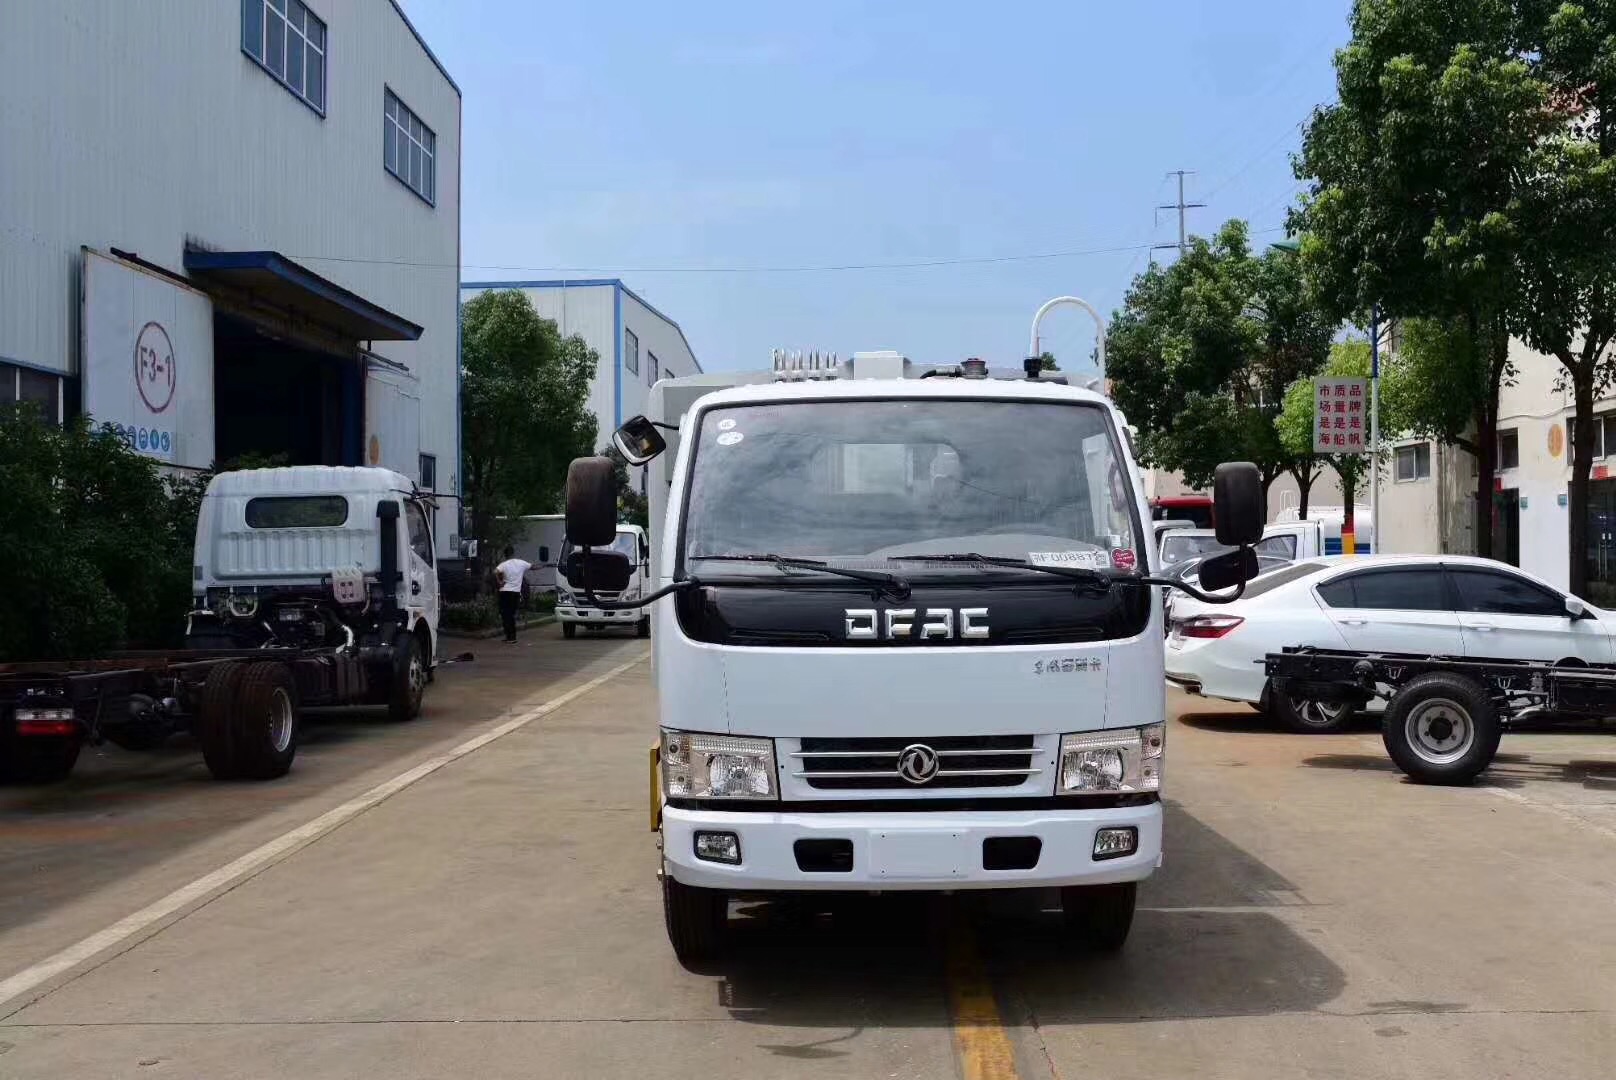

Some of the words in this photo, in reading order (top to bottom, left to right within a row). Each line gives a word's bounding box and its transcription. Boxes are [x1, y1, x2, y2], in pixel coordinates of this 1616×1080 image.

[140, 346, 171, 387] F3-1
[1319, 385, 1331, 445] 市场是海
[1334, 385, 1346, 446] 质量是船
[1349, 385, 1362, 445] 品牌是帆
[845, 607, 990, 640] DFAC
